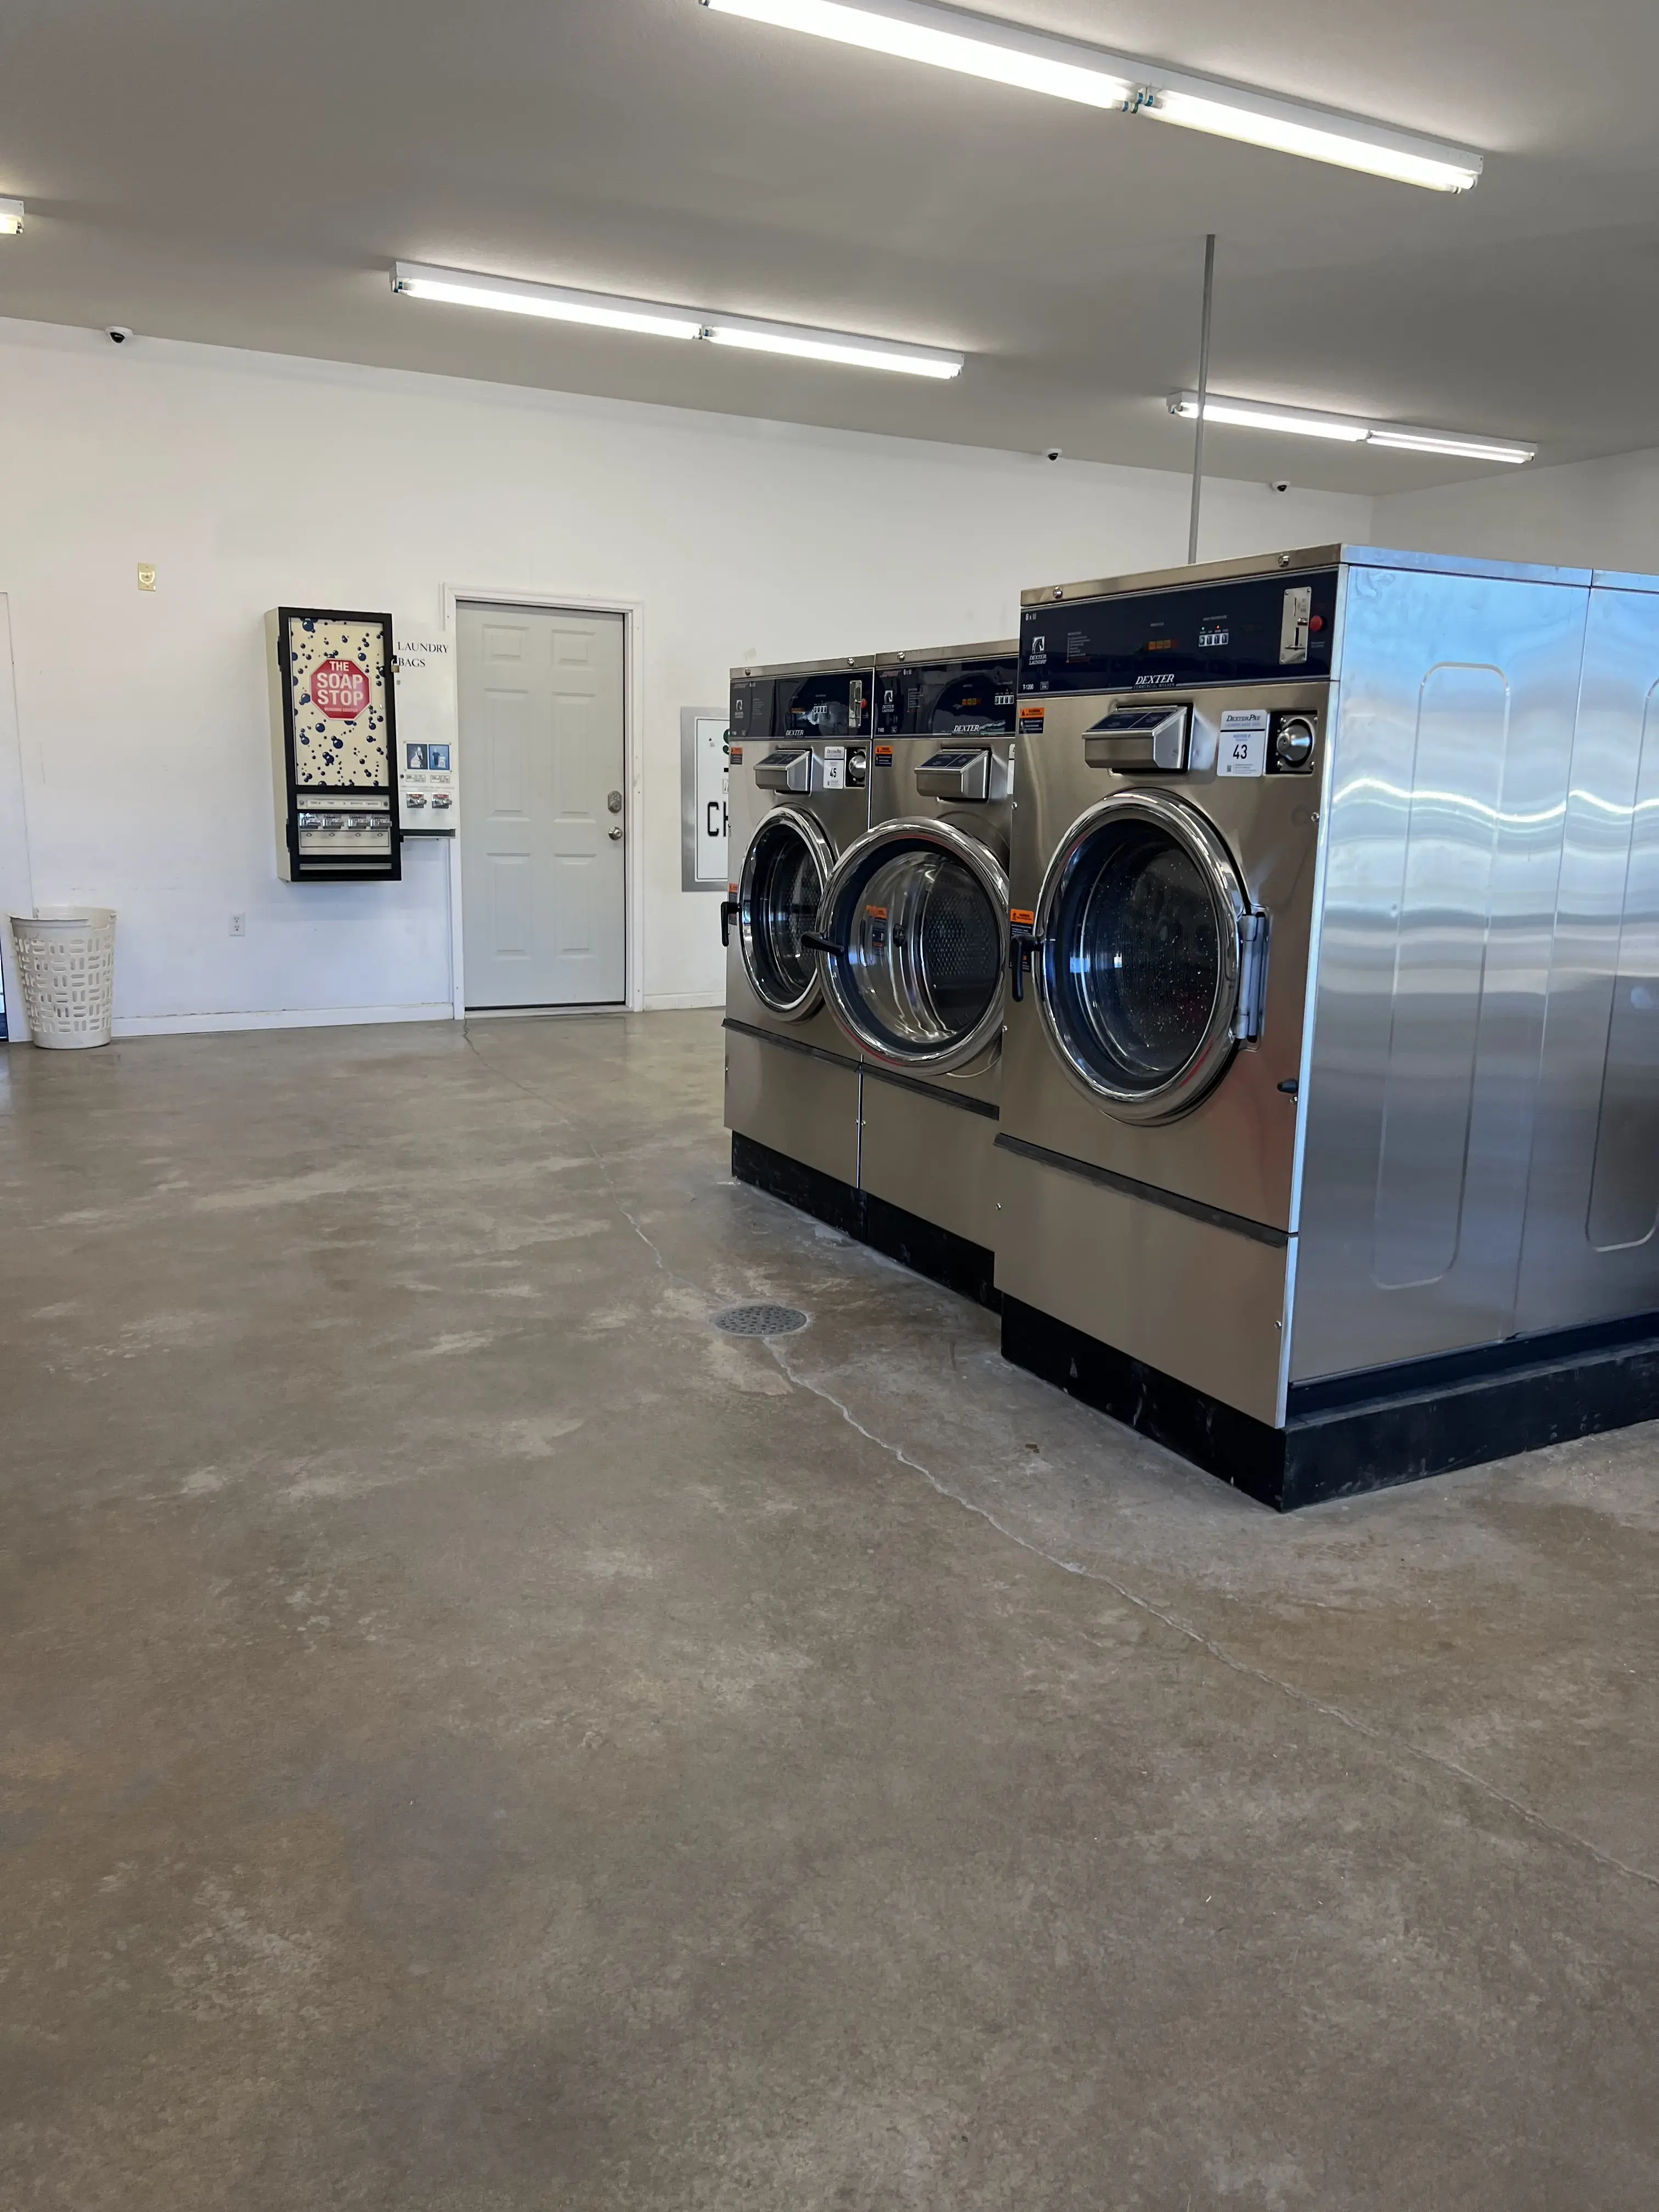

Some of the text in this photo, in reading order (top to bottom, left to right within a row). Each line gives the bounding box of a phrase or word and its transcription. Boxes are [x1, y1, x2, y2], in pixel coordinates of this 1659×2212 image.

[398, 641, 449, 653] LAUNDRY
[329, 661, 349, 672] THE
[398, 657, 426, 667] BAGS
[317, 672, 363, 690] SOAP
[1135, 674, 1175, 685] DEXTER
[317, 689, 364, 706] STOP
[1233, 744, 1248, 759] 43
[830, 768, 837, 778] 45
